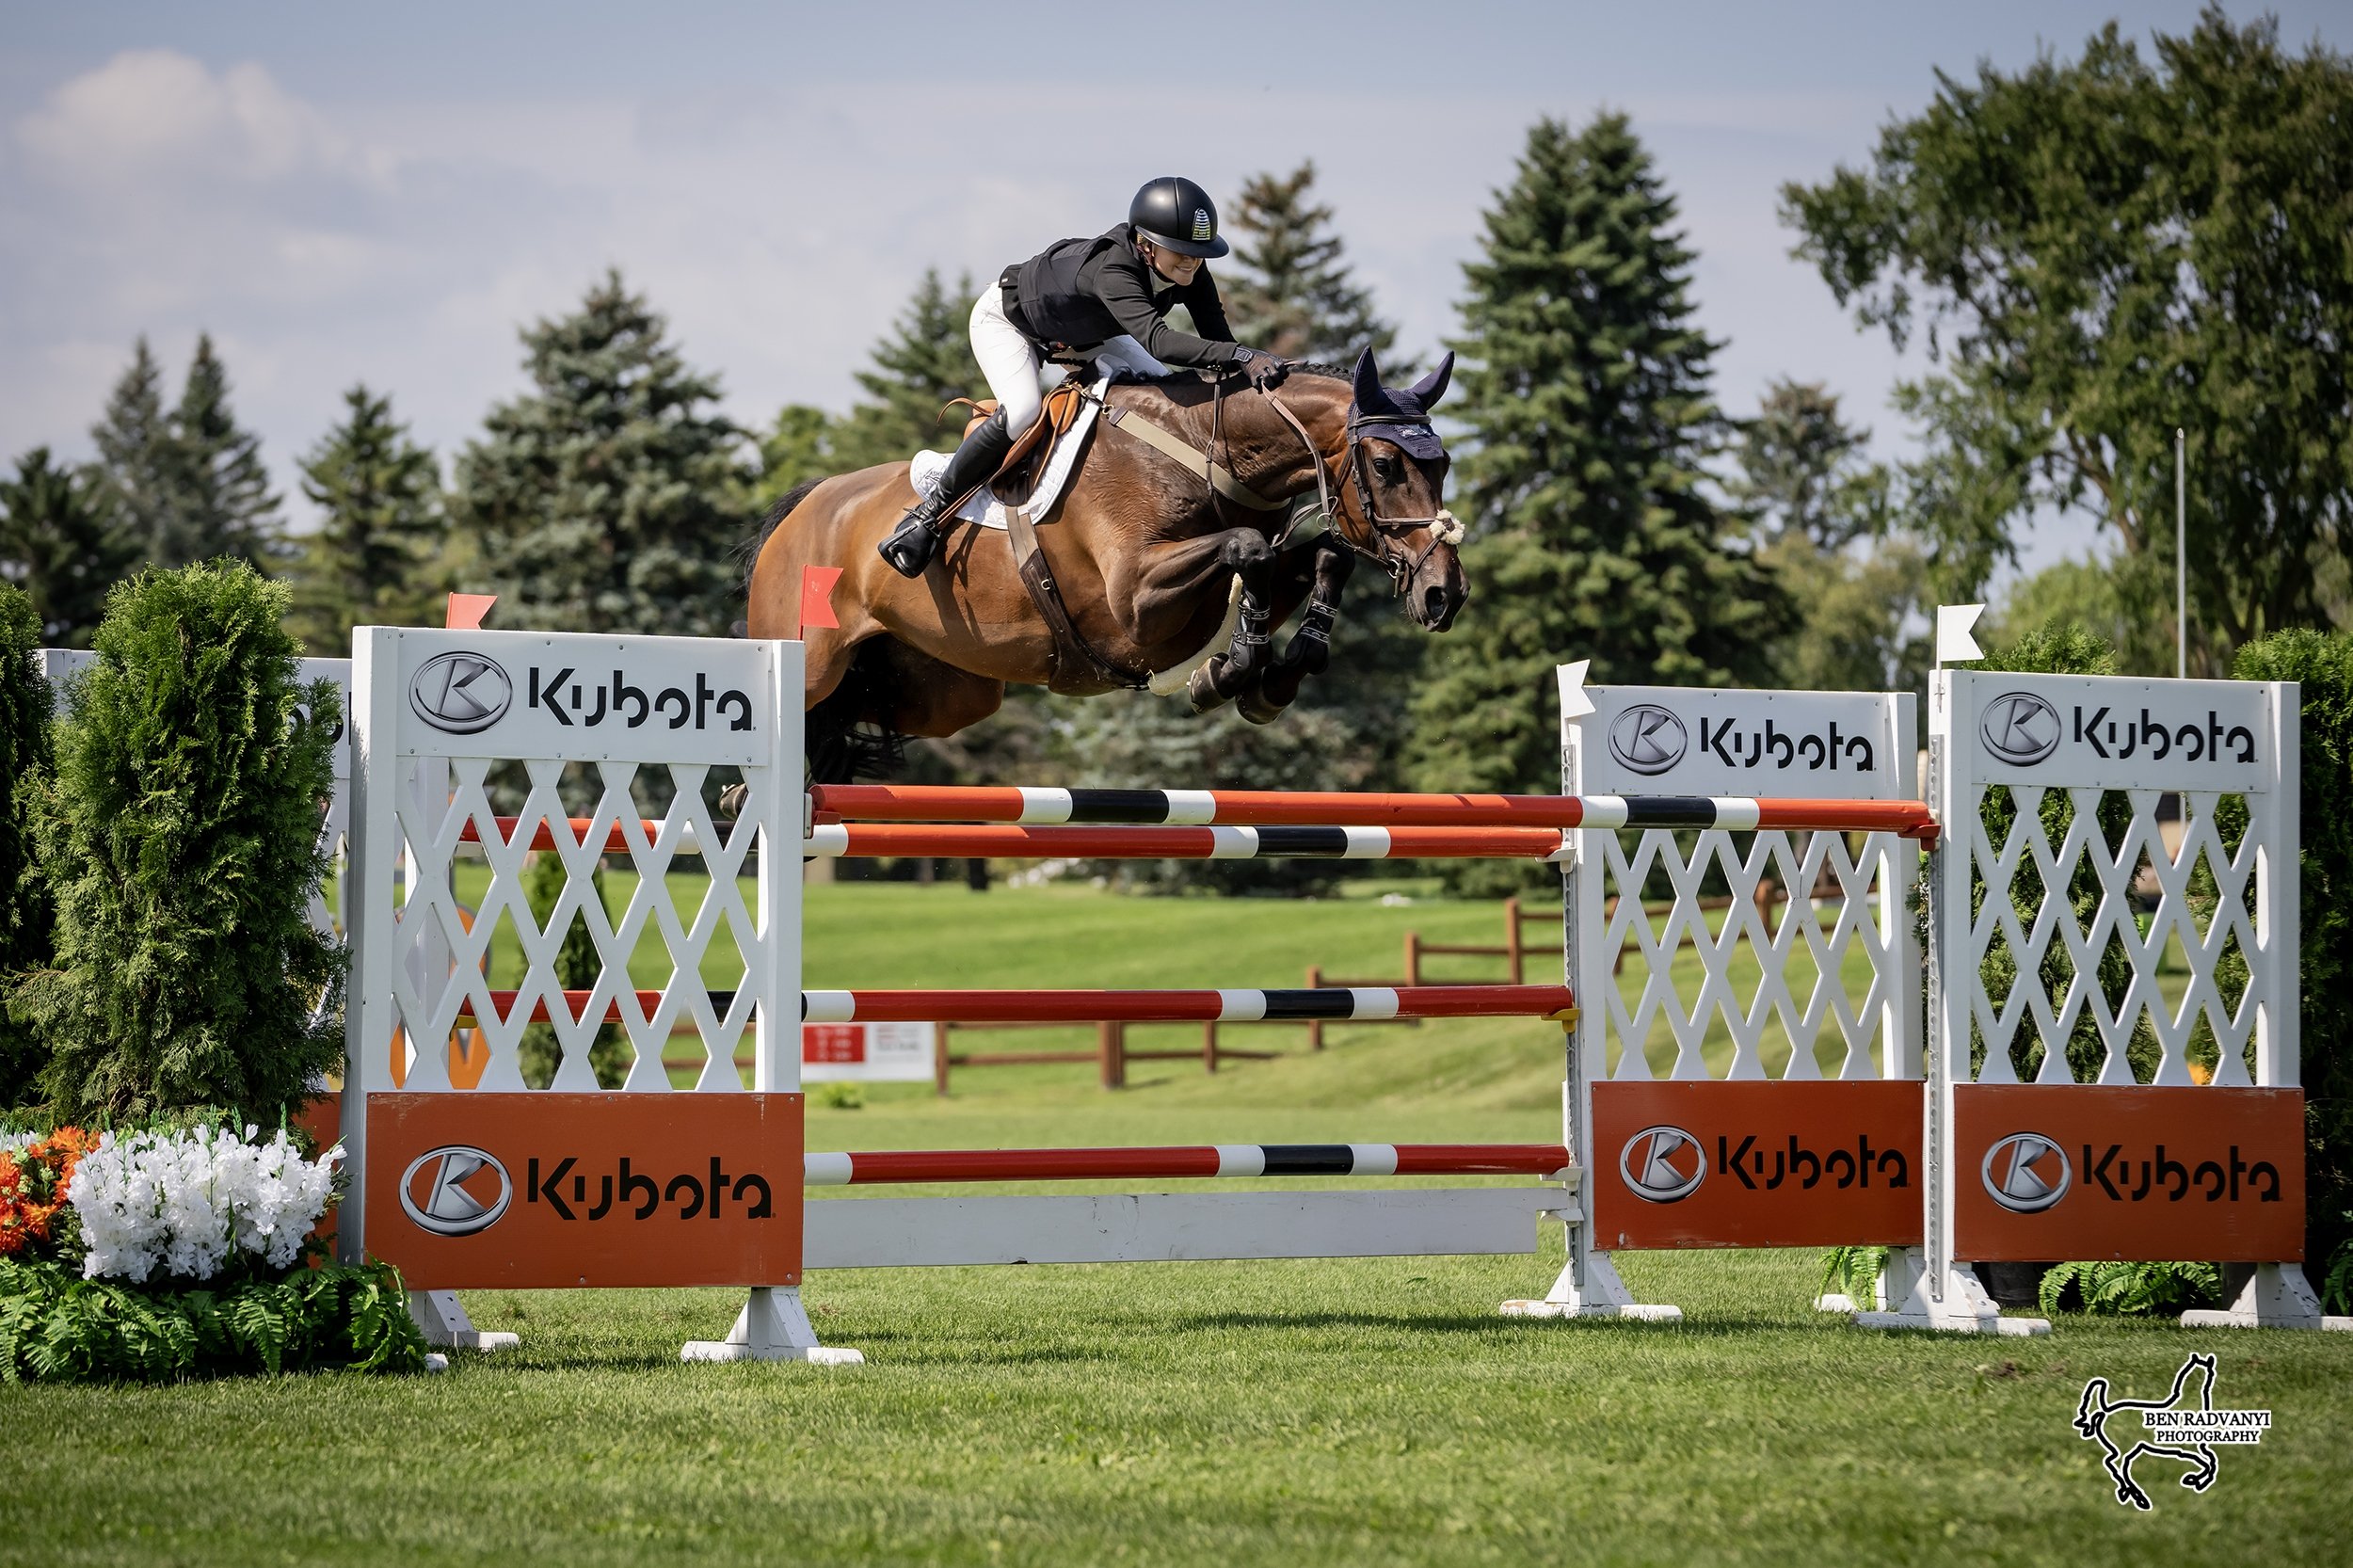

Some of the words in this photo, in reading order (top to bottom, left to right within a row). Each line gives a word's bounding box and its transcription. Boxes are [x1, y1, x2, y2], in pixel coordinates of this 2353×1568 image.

[529, 666, 752, 731] Kubota
[1700, 717, 1873, 772] Kubota
[2073, 706, 2255, 763] Kubota
[527, 1156, 772, 1222] Kubota
[1718, 1133, 1908, 1191] Kubota
[2082, 1144, 2281, 1203] Kubota
